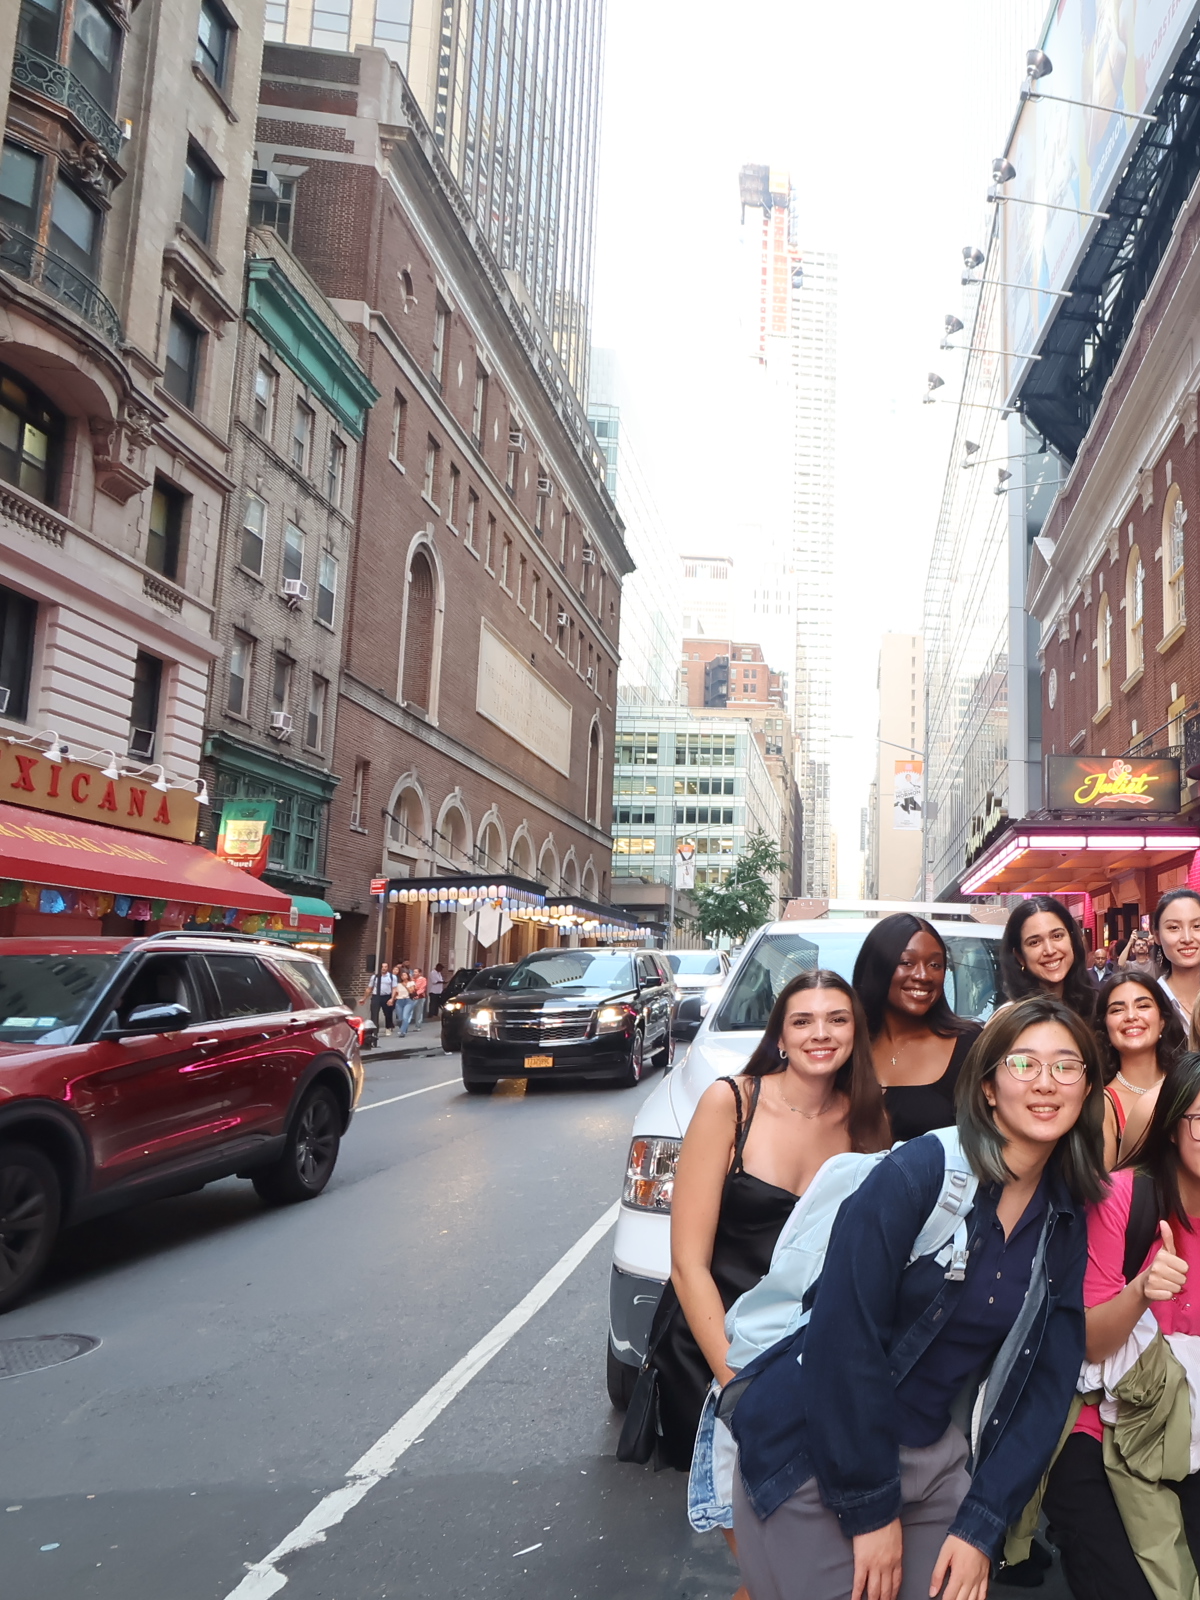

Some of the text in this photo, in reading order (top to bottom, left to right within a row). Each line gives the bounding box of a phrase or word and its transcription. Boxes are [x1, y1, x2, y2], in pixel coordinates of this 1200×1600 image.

[11, 755, 171, 825] XICANA
[1074, 772, 1159, 804] Juliet
[450, 890, 485, 898] HALL
